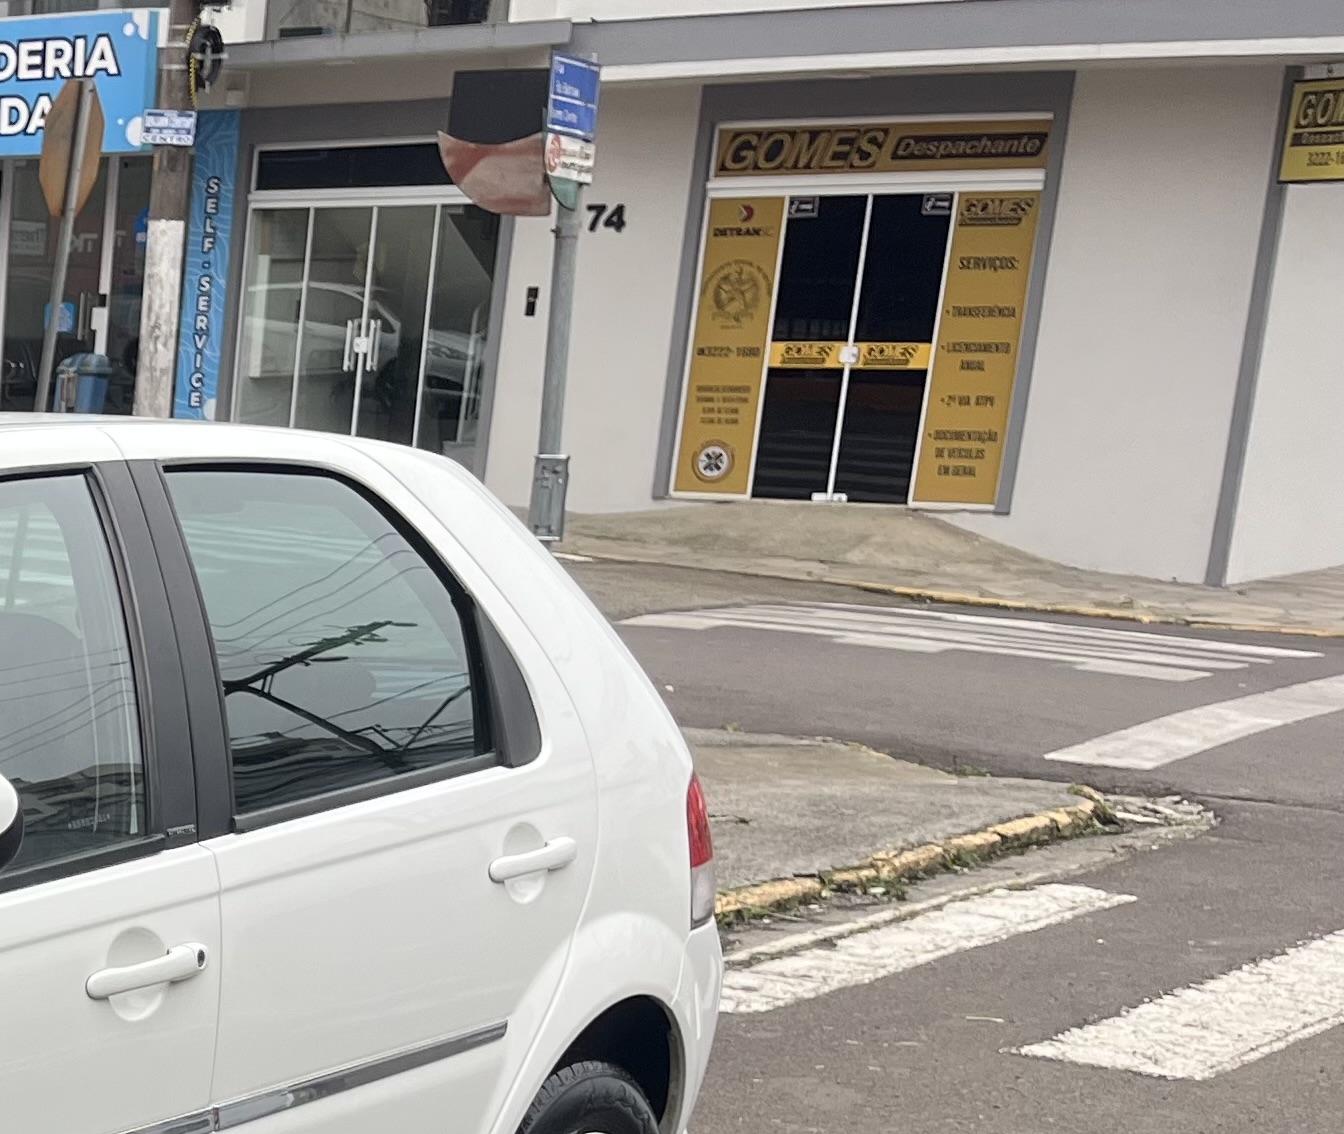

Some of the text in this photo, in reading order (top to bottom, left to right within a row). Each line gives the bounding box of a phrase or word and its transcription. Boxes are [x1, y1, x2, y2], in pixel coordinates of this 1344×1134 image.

[720, 128, 1041, 170] GOMES Despachante
[586, 203, 626, 233] 74
